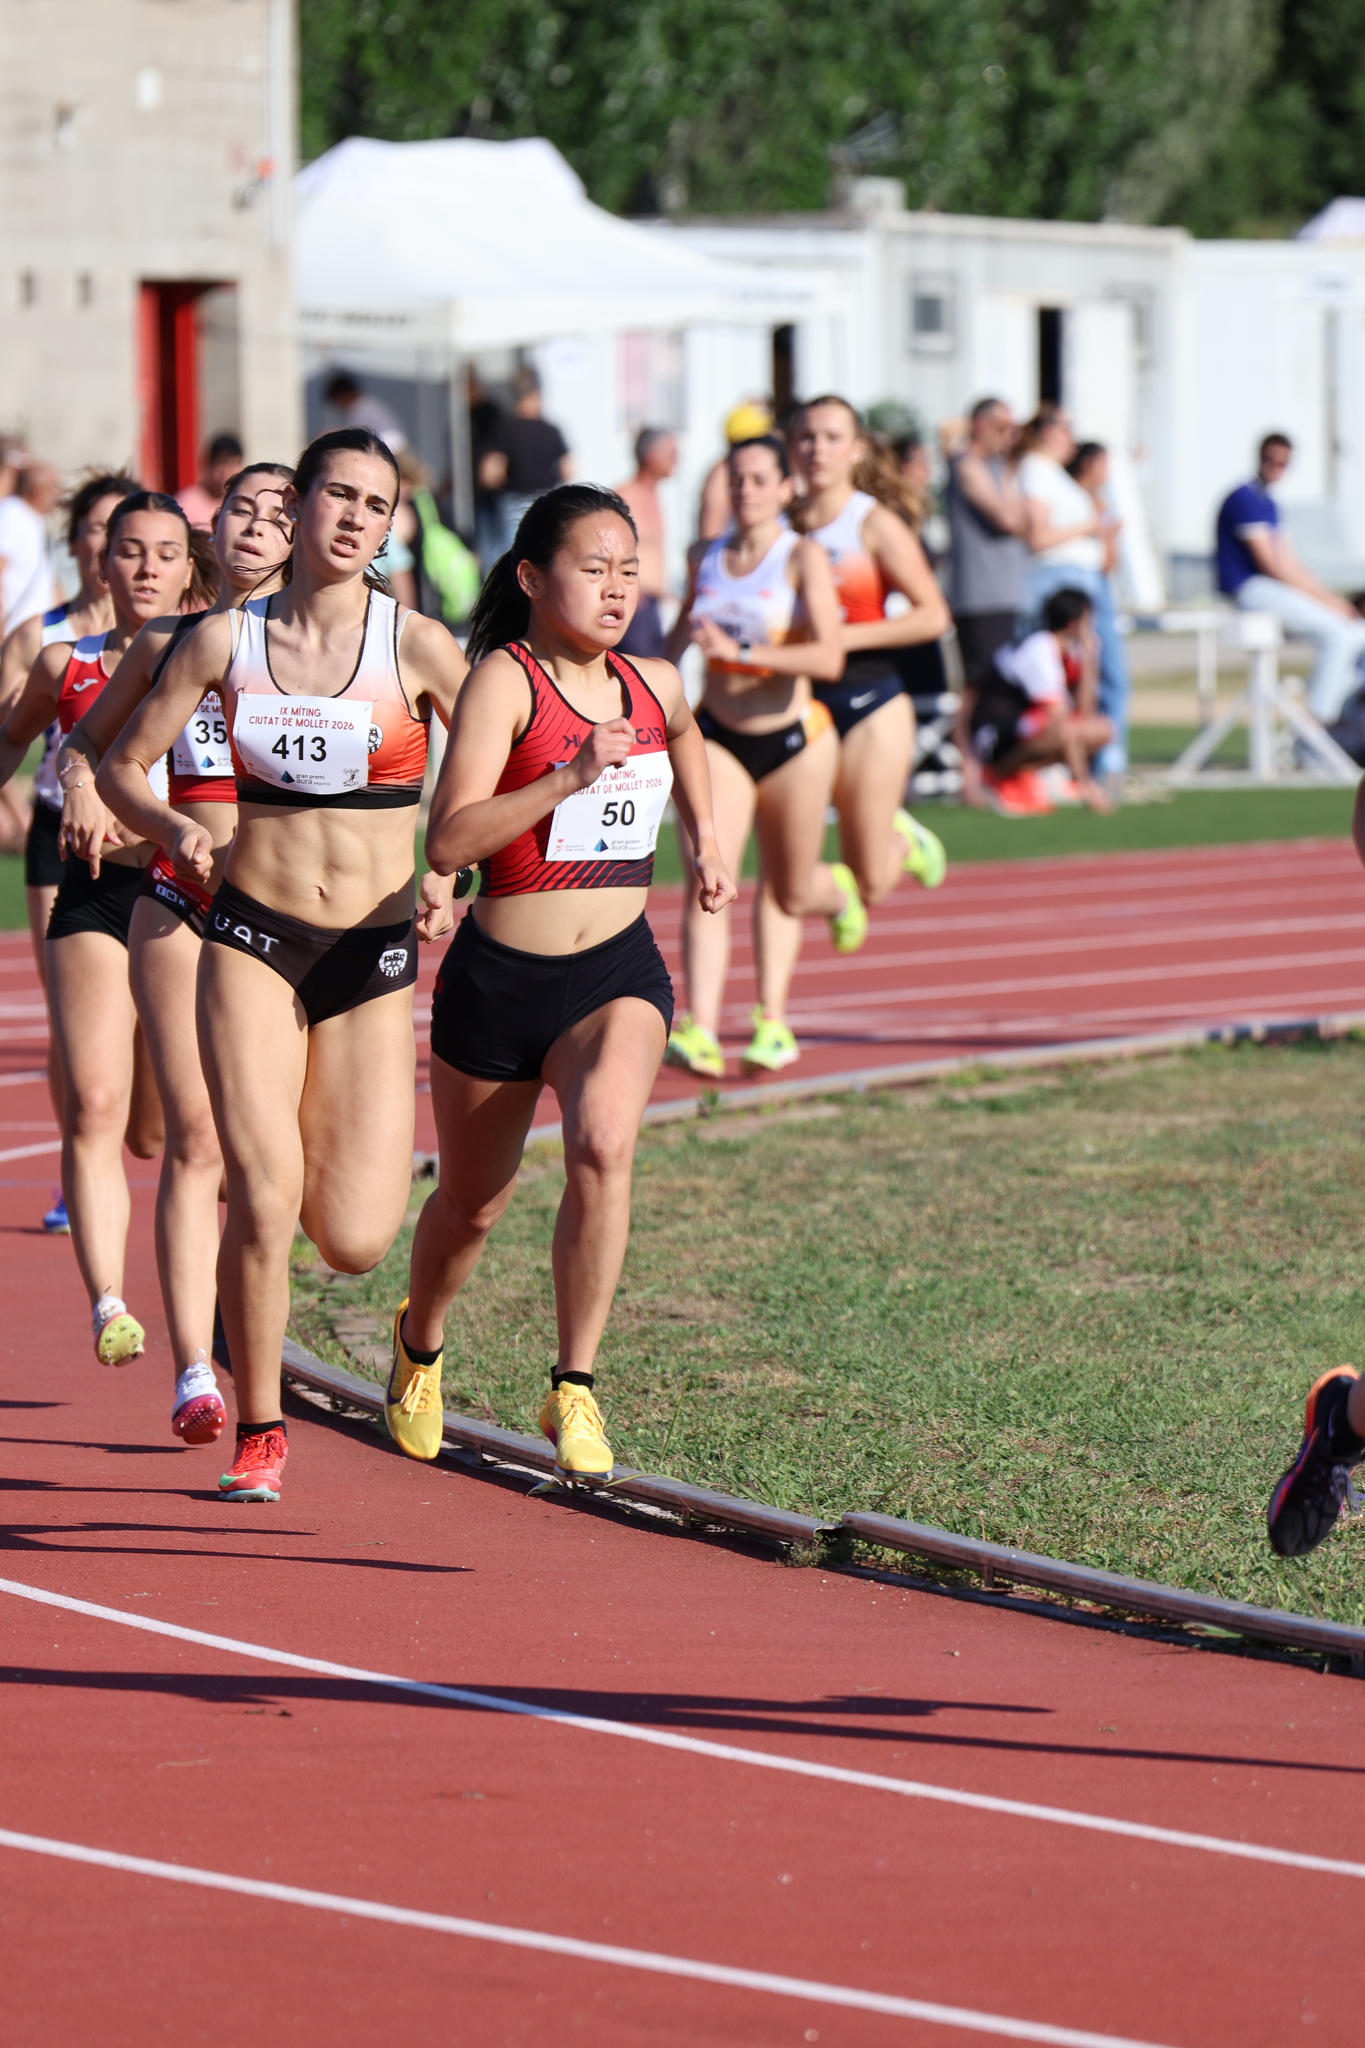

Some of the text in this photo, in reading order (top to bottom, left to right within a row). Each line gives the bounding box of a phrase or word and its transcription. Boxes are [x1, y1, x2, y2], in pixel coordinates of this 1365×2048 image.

[280, 706, 288, 715] IX
[249, 716, 354, 731] CIUTAT DE MOLLET 2026
[272, 734, 327, 762] 413
[601, 773, 607, 782] IX
[604, 784, 613, 793] DE
[615, 780, 643, 792] MOLLET
[646, 777, 662, 789] 2026
[601, 800, 635, 827] 50
